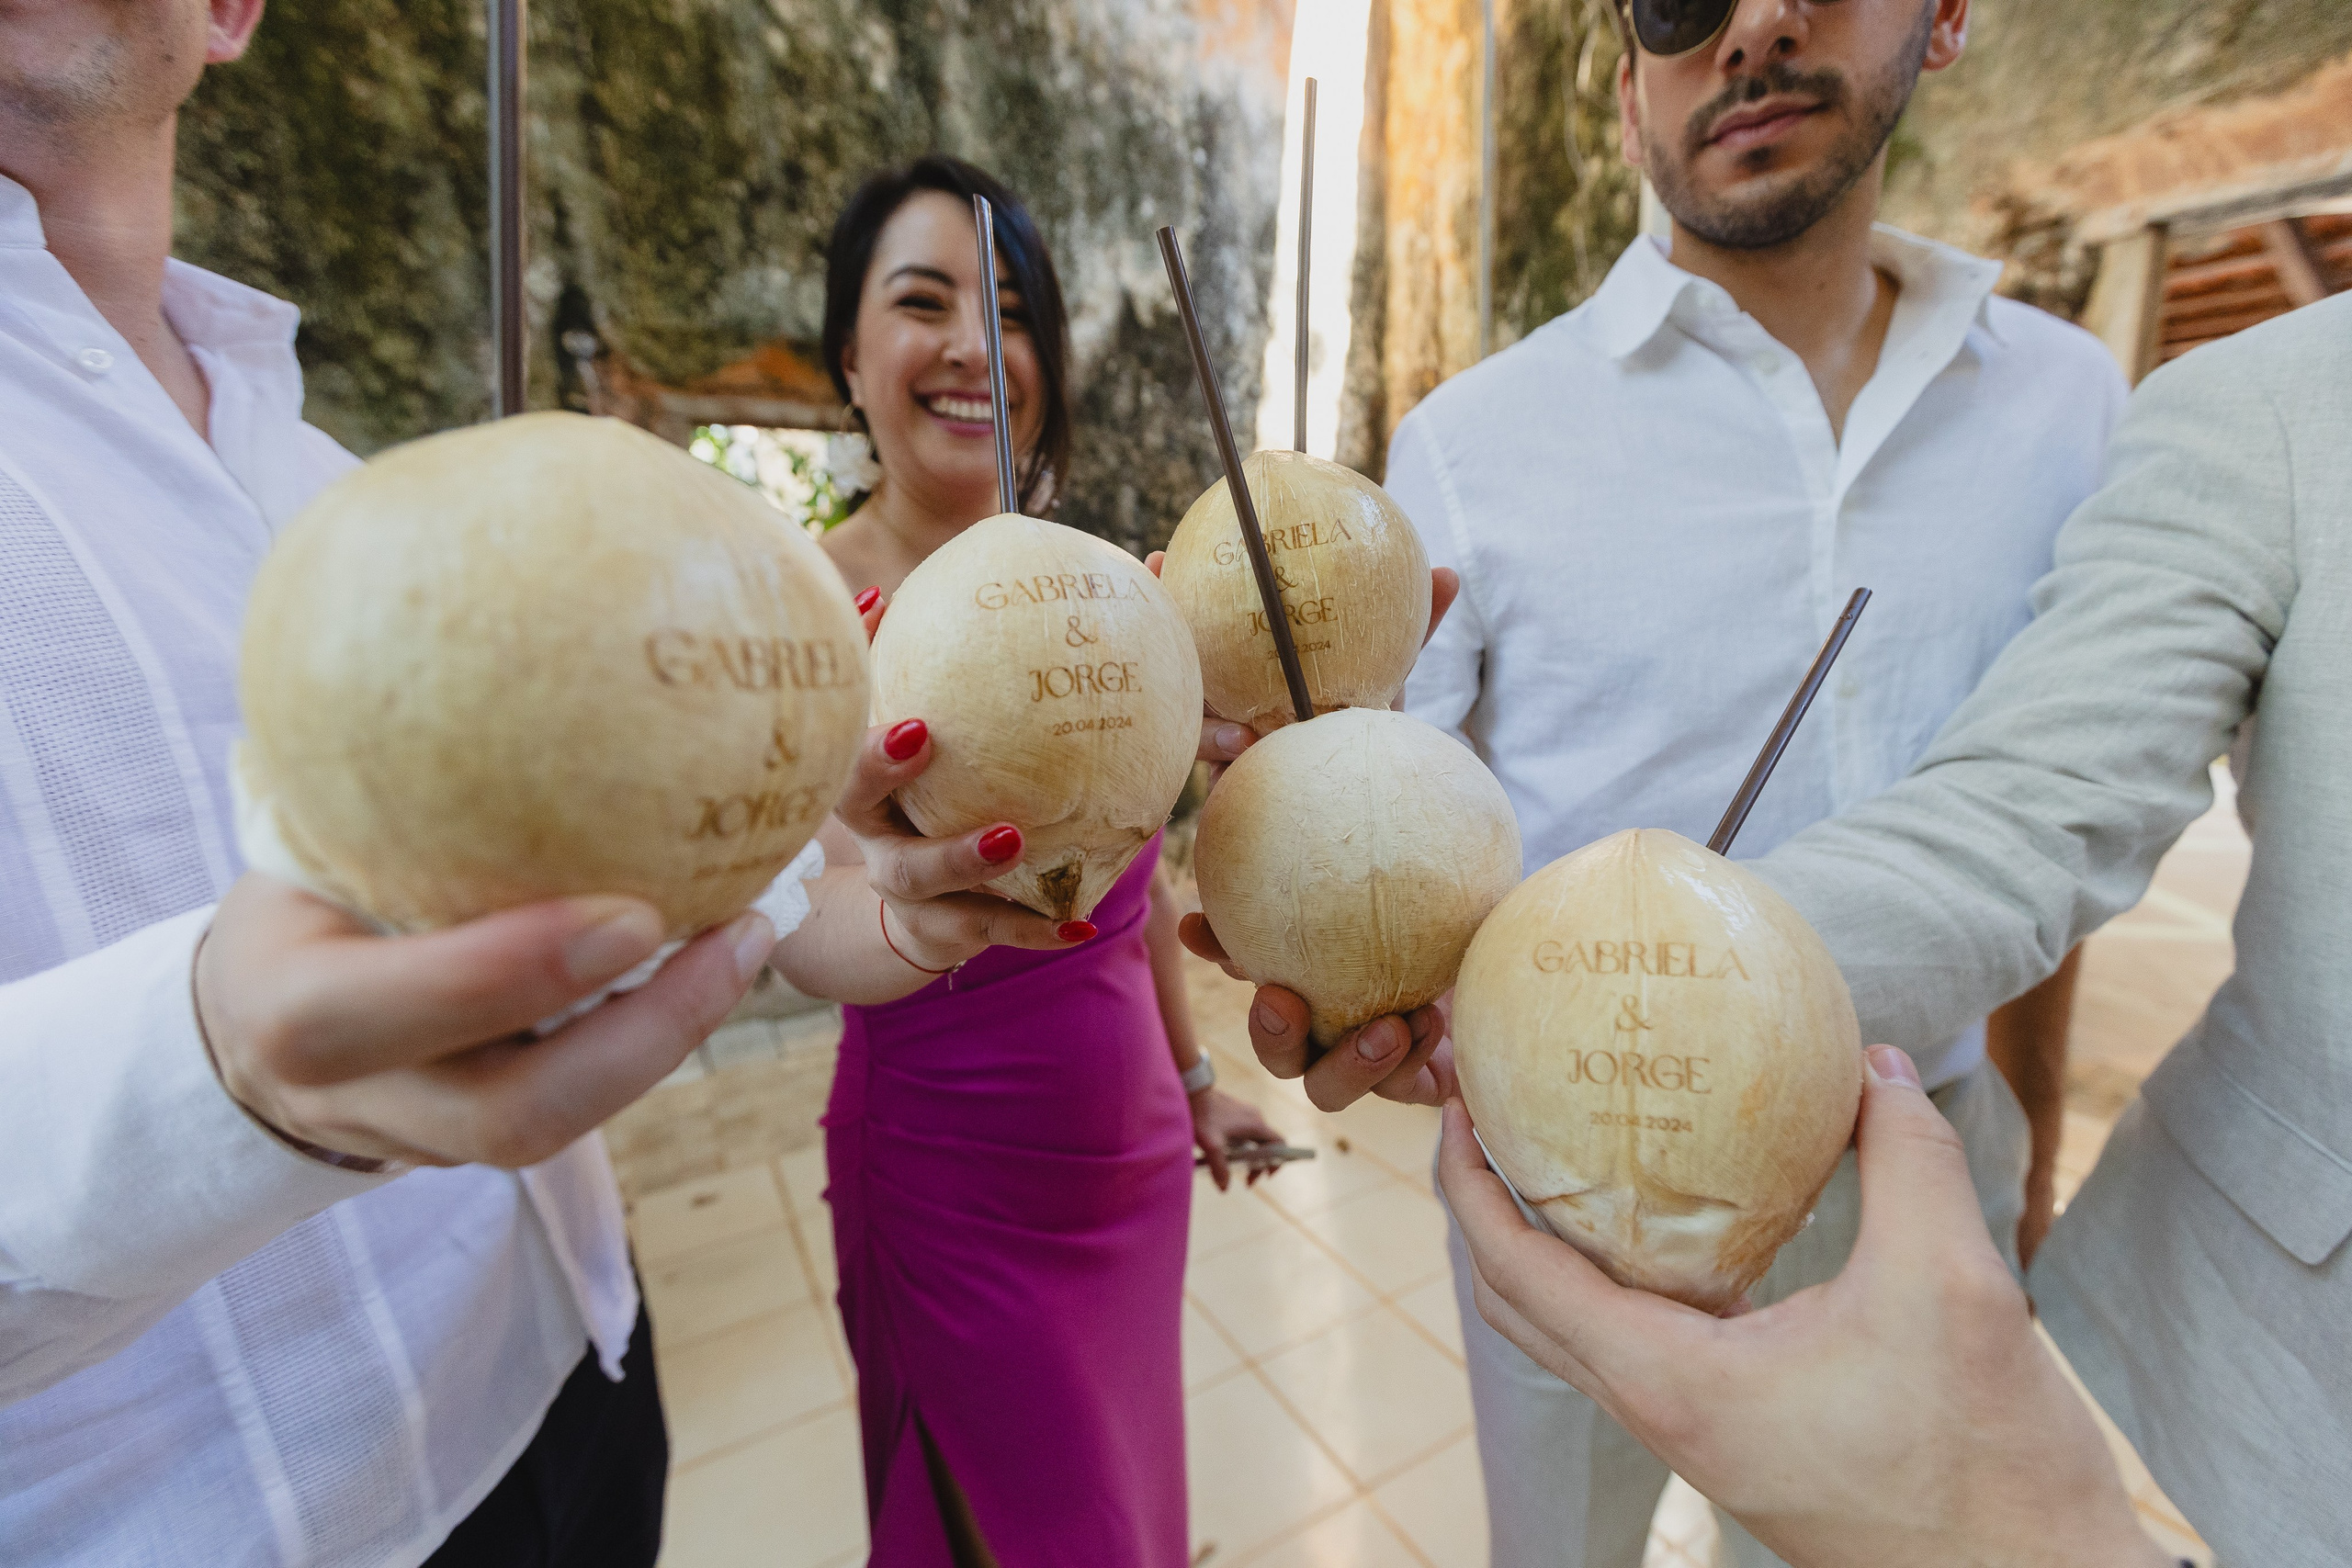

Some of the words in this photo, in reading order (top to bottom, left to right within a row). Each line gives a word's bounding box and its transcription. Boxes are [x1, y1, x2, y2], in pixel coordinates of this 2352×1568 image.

[975, 573, 1149, 610] GABRIELA
[1065, 615, 1098, 647] &
[1028, 661, 1142, 703] JORGE
[1532, 940, 1750, 981] GABRIELA
[1614, 994, 1655, 1032] &
[1566, 1048, 1713, 1094] JORGE
